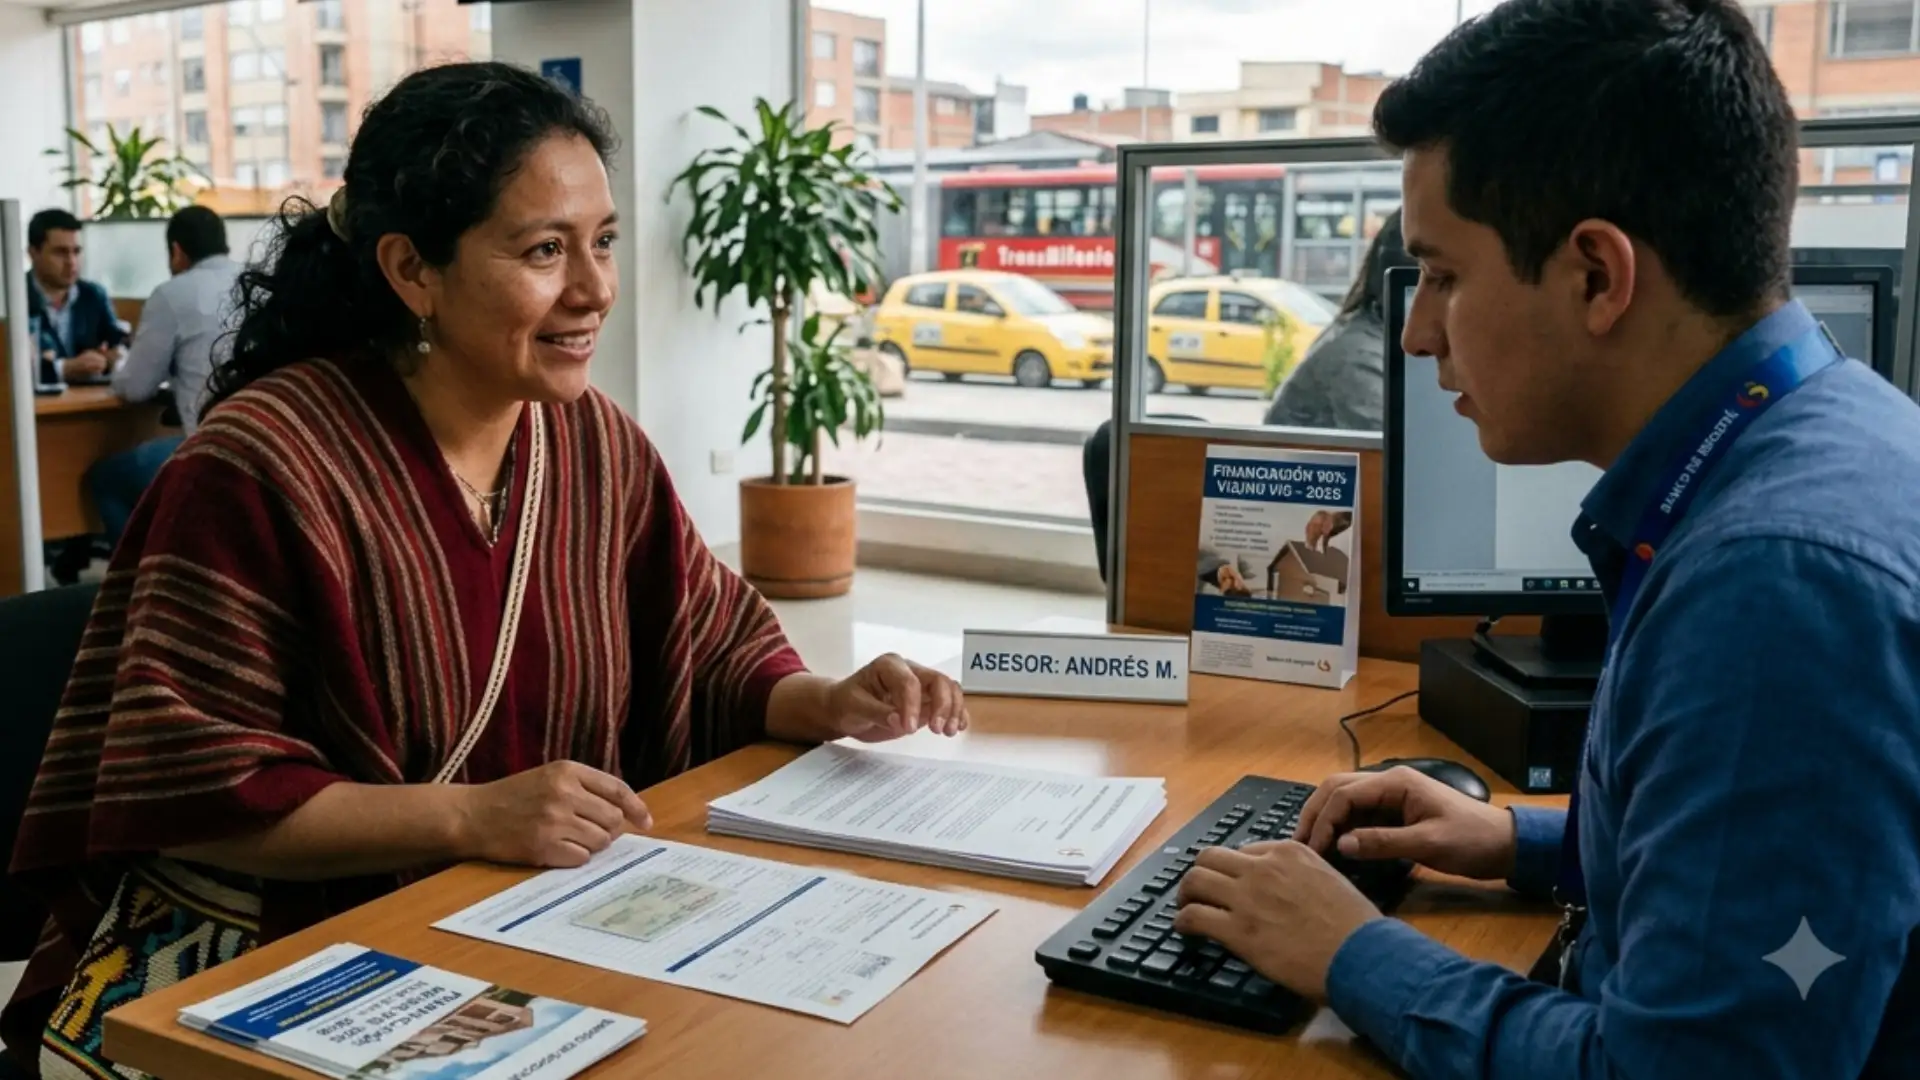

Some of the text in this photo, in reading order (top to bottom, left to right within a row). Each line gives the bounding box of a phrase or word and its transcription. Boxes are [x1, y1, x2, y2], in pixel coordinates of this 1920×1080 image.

[970, 653, 1178, 680] ASESOR: ANDRÉS M.
